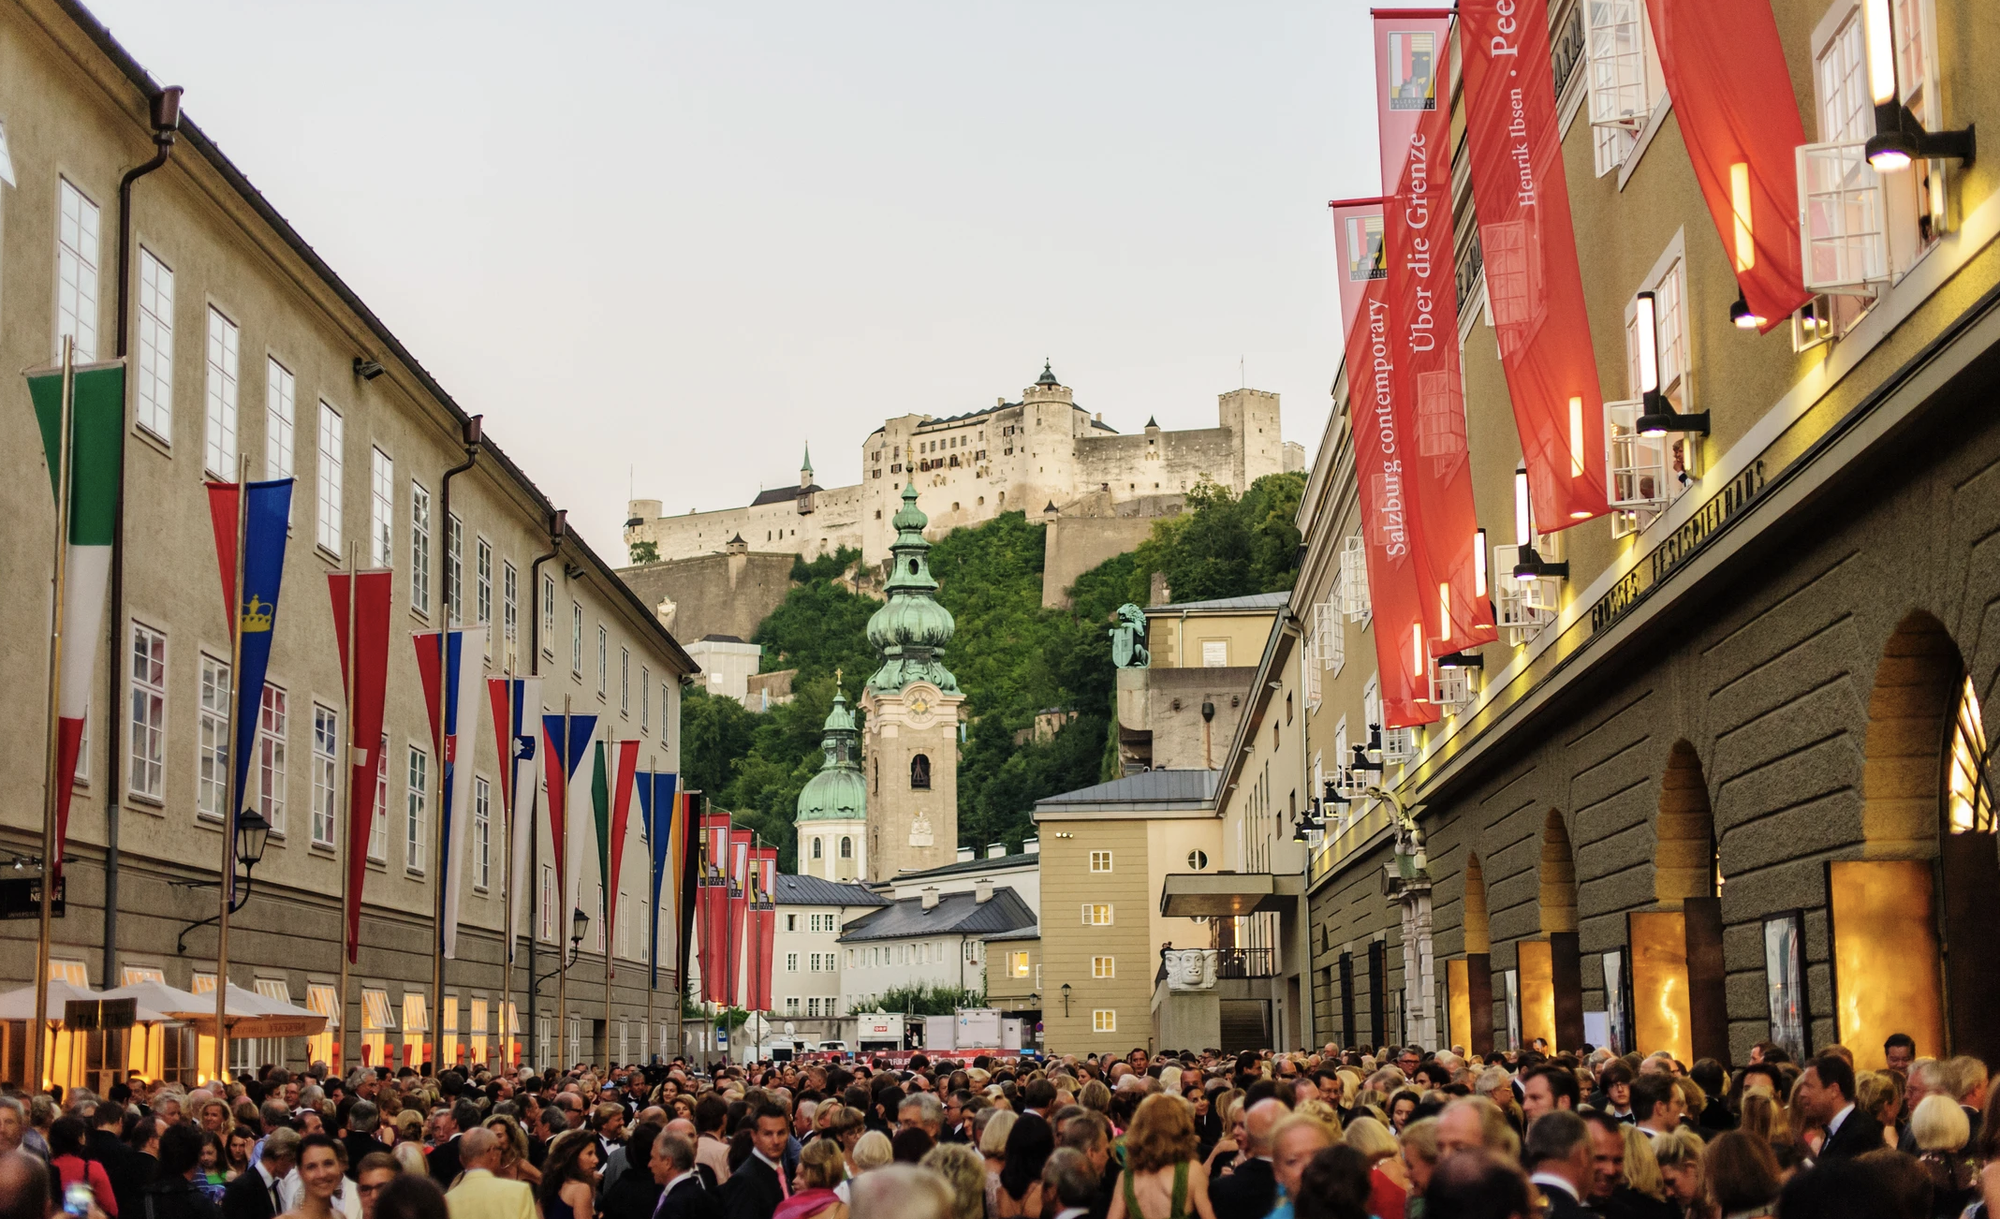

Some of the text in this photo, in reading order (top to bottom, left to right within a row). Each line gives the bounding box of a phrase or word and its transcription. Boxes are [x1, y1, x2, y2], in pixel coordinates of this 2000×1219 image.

[1491, 0, 1536, 207] Henrik Ibsen Pee
[1405, 132, 1436, 354] Über die Grenze
[1368, 298, 1406, 556] Salzburg contemporary
[1652, 460, 1765, 582] FESTSPIELHAUS
